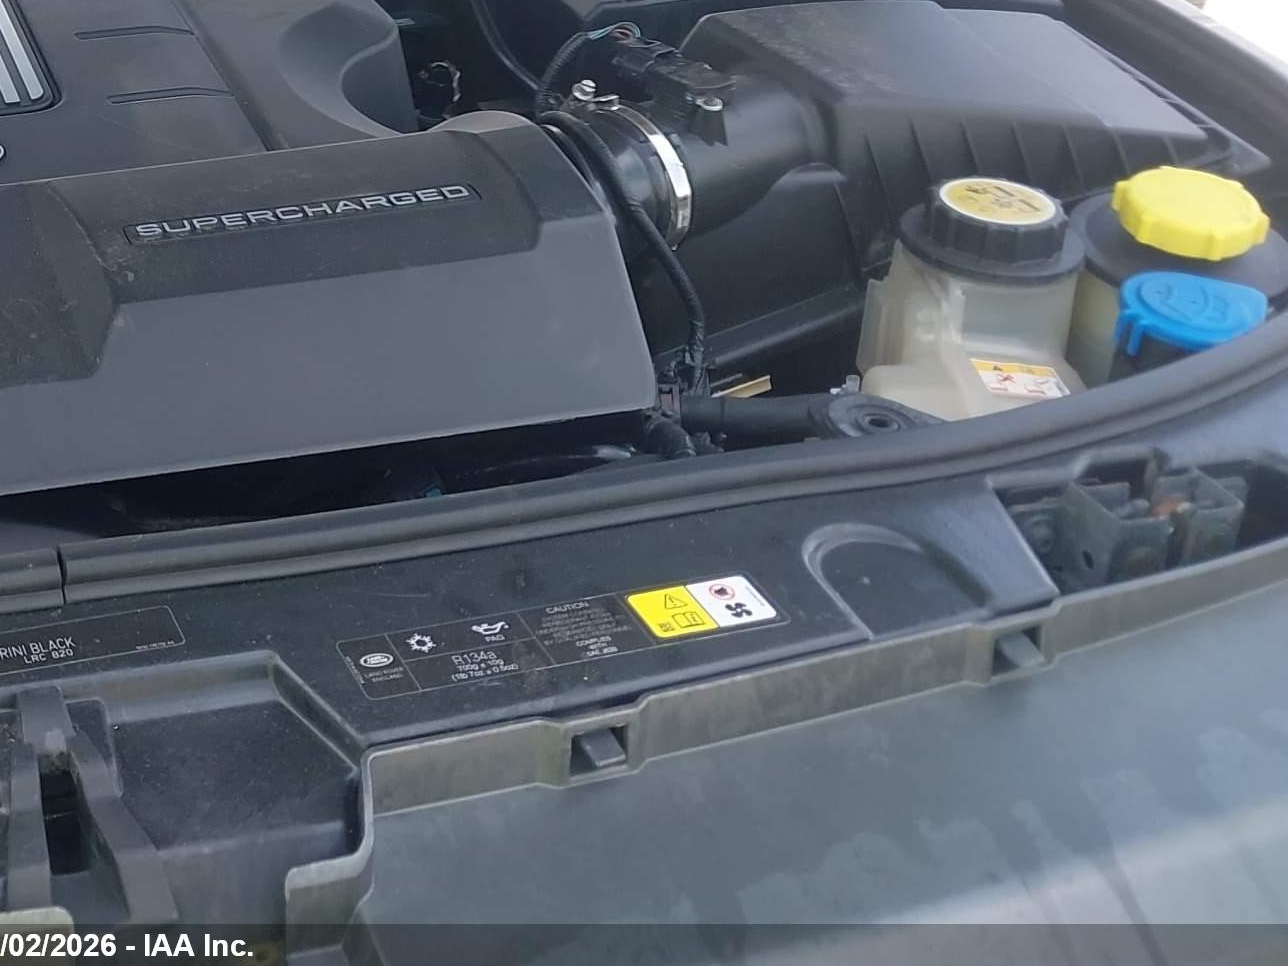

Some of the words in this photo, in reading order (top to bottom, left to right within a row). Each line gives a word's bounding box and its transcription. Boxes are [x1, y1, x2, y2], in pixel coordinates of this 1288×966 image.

[135, 185, 471, 237] SUPERCHARGED
[545, 601, 590, 614] CAUTION
[30, 636, 76, 655] BLACK
[24, 652, 47, 664] LRC
[52, 648, 74, 659] 820
[451, 650, 497, 666] R134a
